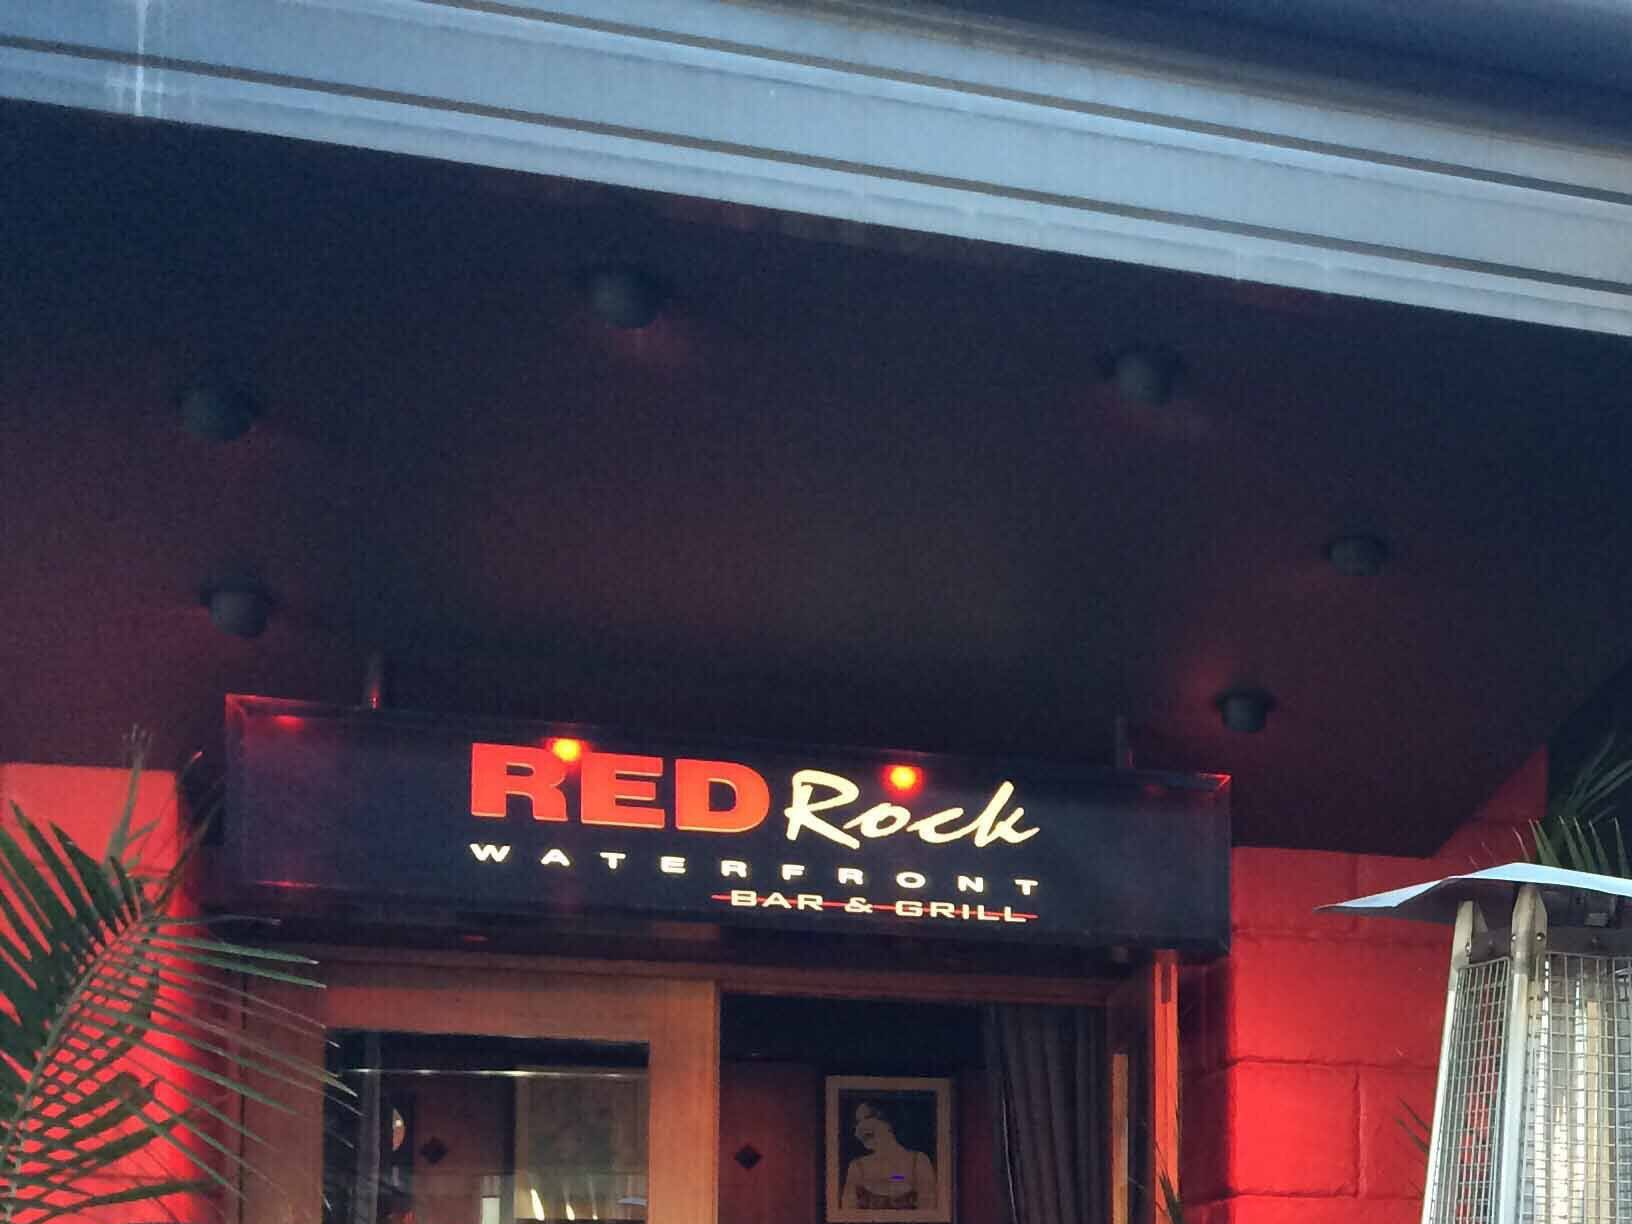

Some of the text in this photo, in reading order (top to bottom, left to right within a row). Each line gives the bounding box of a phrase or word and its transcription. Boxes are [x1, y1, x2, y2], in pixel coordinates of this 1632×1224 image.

[470, 743, 1040, 848] RED Rock
[469, 843, 1038, 895] WATERFRONT
[730, 889, 1028, 922] BAR & GRILL
